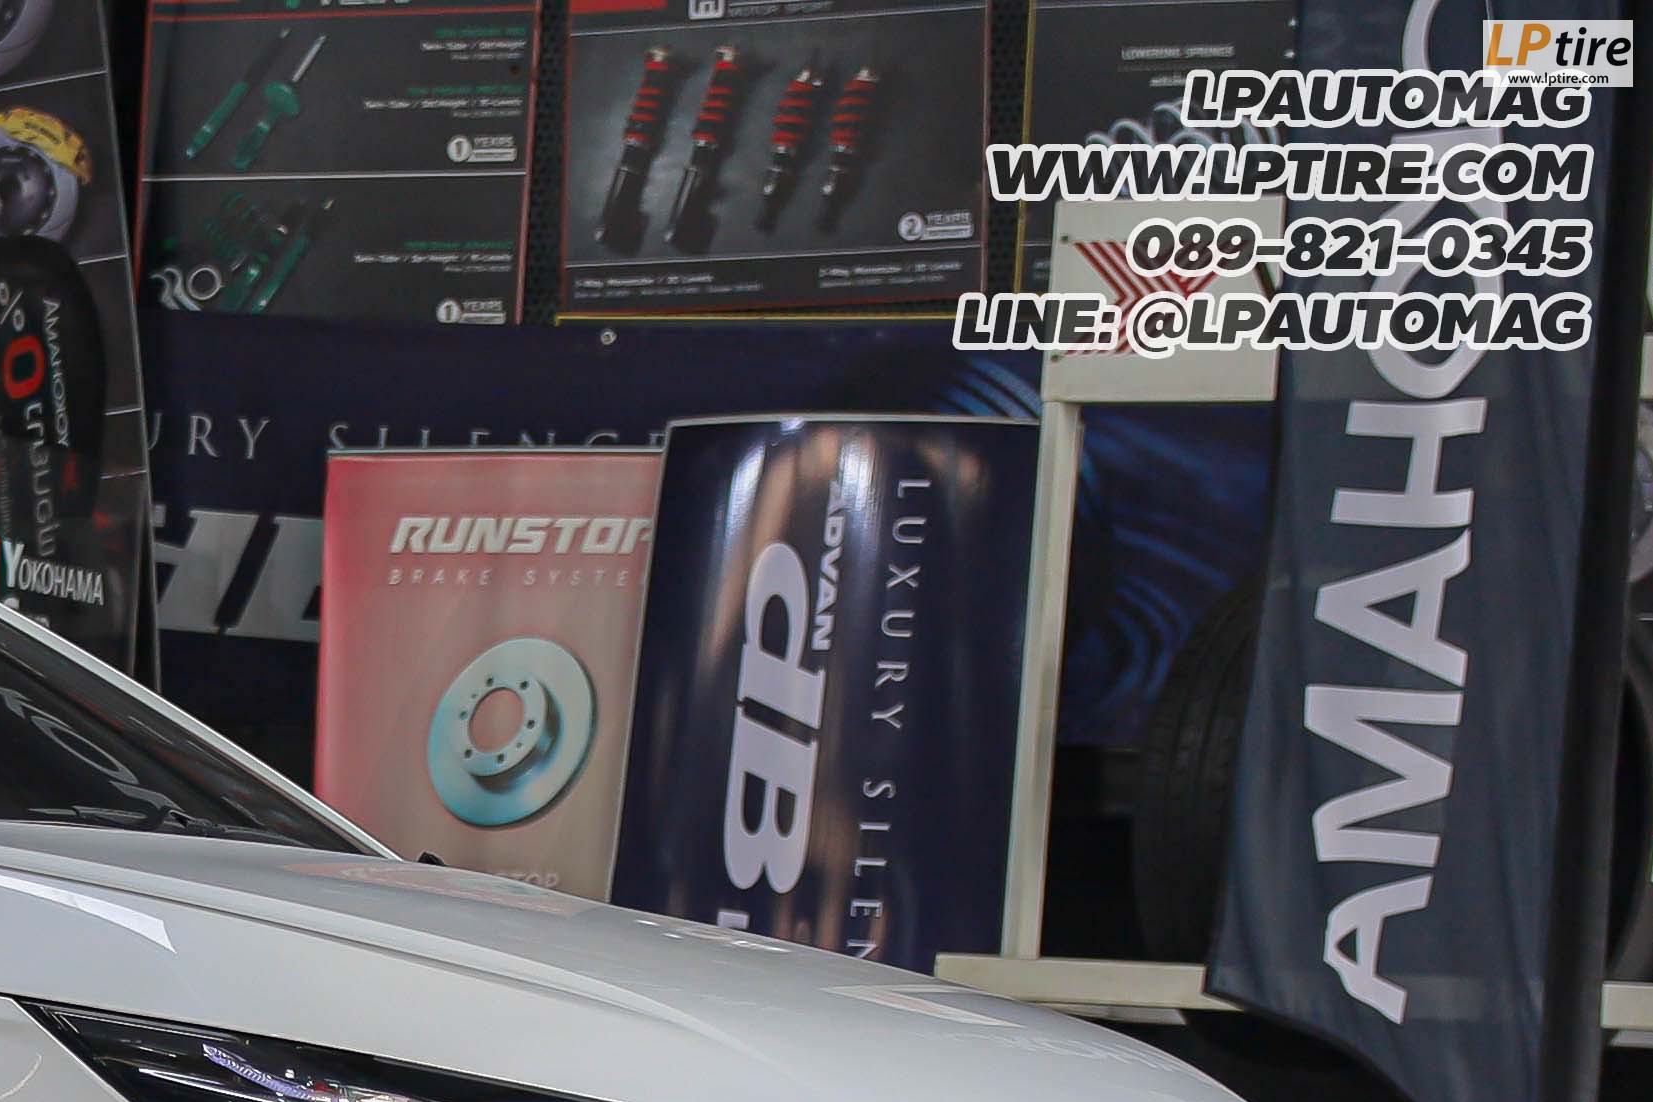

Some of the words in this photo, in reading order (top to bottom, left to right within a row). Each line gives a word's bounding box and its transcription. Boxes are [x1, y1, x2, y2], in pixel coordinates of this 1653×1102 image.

[2, 540, 104, 606] YOKOHAMA
[387, 568, 491, 587] BRAKE
[810, 480, 848, 652] ADVAN
[871, 478, 932, 733] LUXURY
